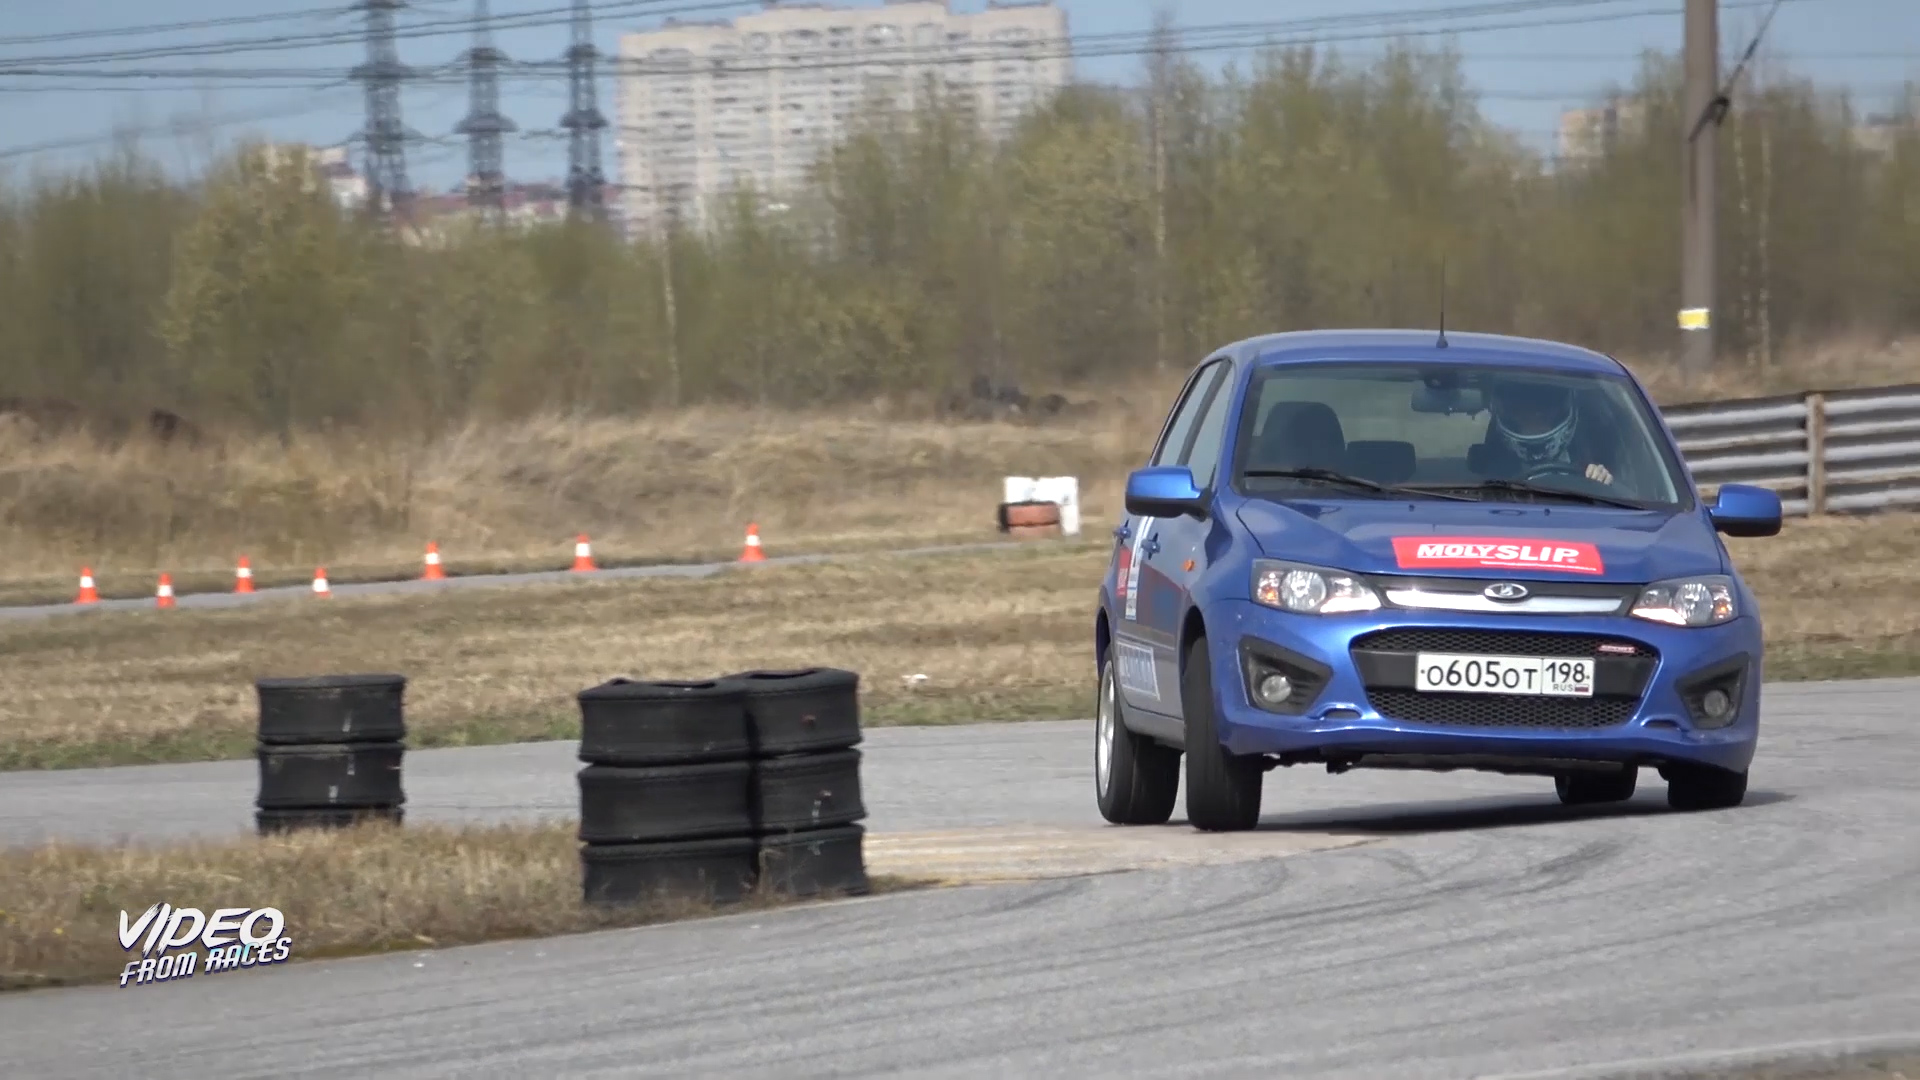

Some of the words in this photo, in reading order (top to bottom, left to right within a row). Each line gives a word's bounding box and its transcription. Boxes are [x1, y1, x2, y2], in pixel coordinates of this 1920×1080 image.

[1417, 543, 1579, 562] MOLYSLIP
[1545, 662, 1585, 684] 198
[1553, 684, 1573, 692] RUS
